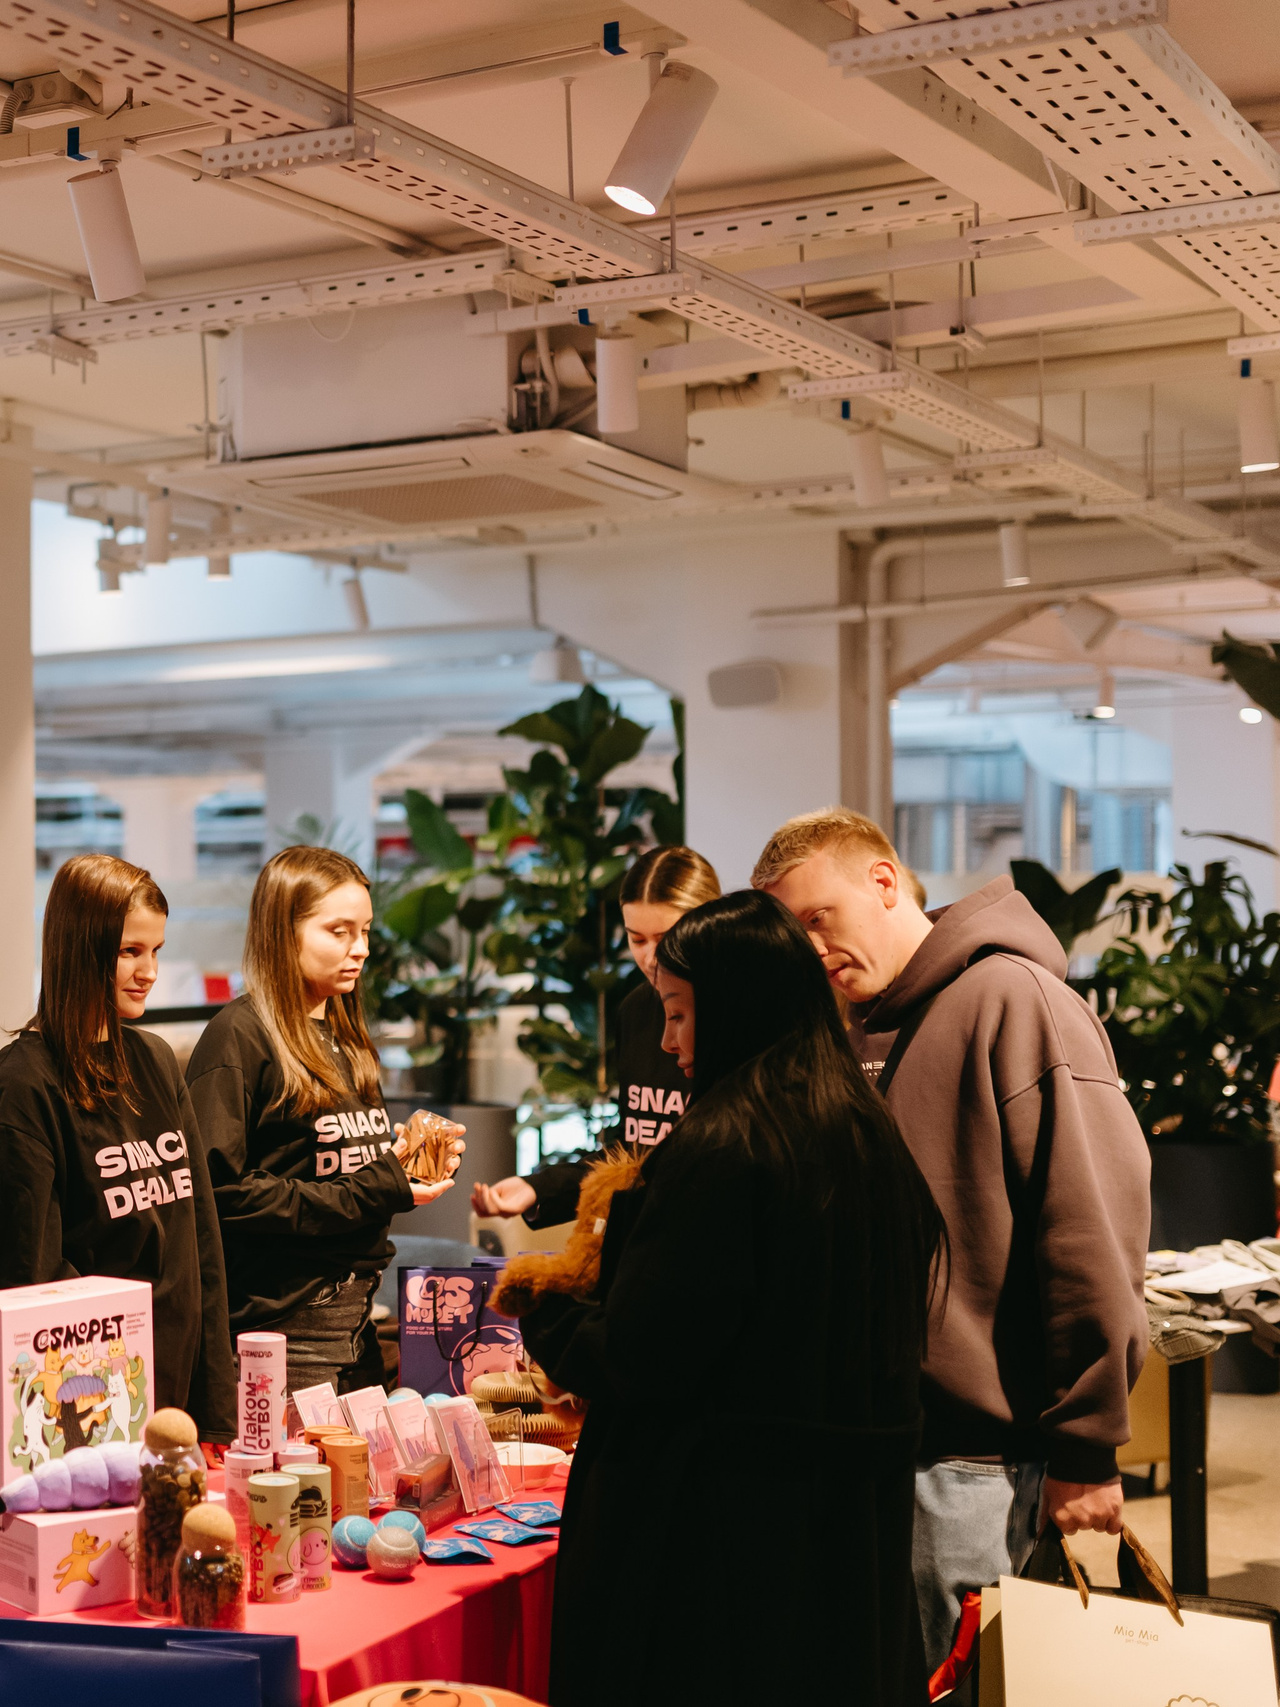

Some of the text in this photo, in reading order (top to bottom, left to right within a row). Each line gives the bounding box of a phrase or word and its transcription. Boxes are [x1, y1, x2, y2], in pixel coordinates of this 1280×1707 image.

[627, 1084, 692, 1116] SNA
[624, 1117, 673, 1146] DEA
[95, 1130, 189, 1178] SNAC
[103, 1168, 193, 1219] DEALE
[1114, 1625, 1159, 1641] Mio Mia
